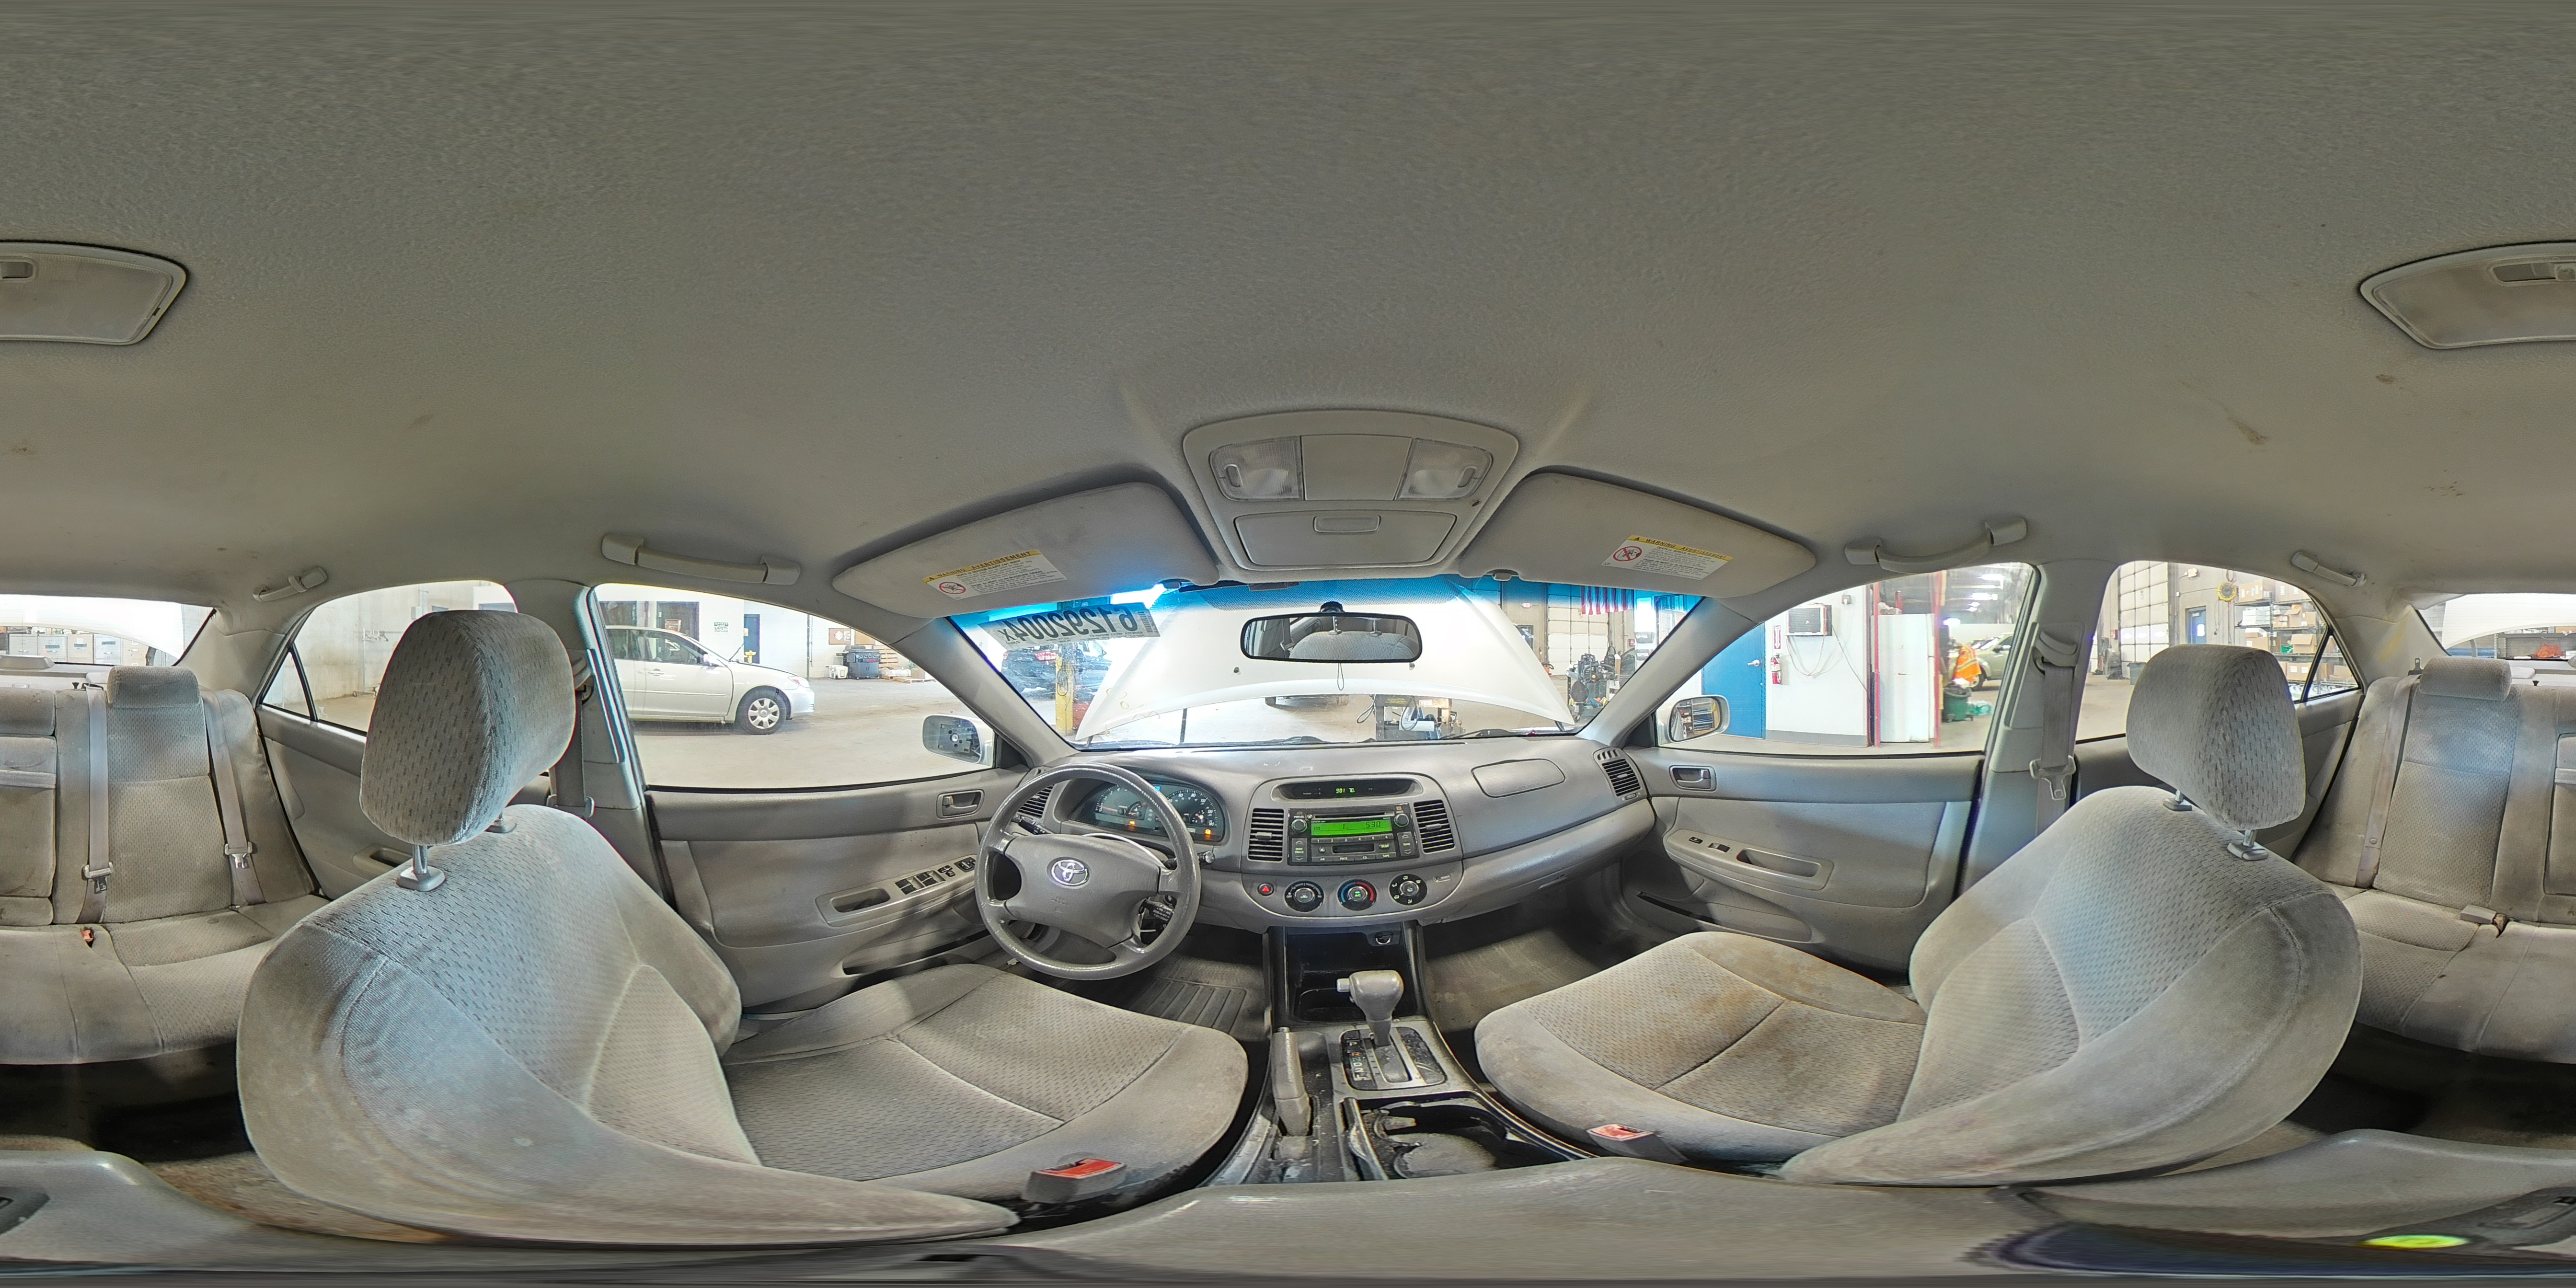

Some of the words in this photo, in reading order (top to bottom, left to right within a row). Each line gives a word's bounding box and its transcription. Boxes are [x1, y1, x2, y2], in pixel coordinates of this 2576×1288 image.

[1646, 539, 1676, 548] WARNING
[1681, 547, 1727, 559] AVERTISSEMENT
[937, 568, 966, 577] WARNING
[972, 551, 1031, 570] AVERTISSEMENT
